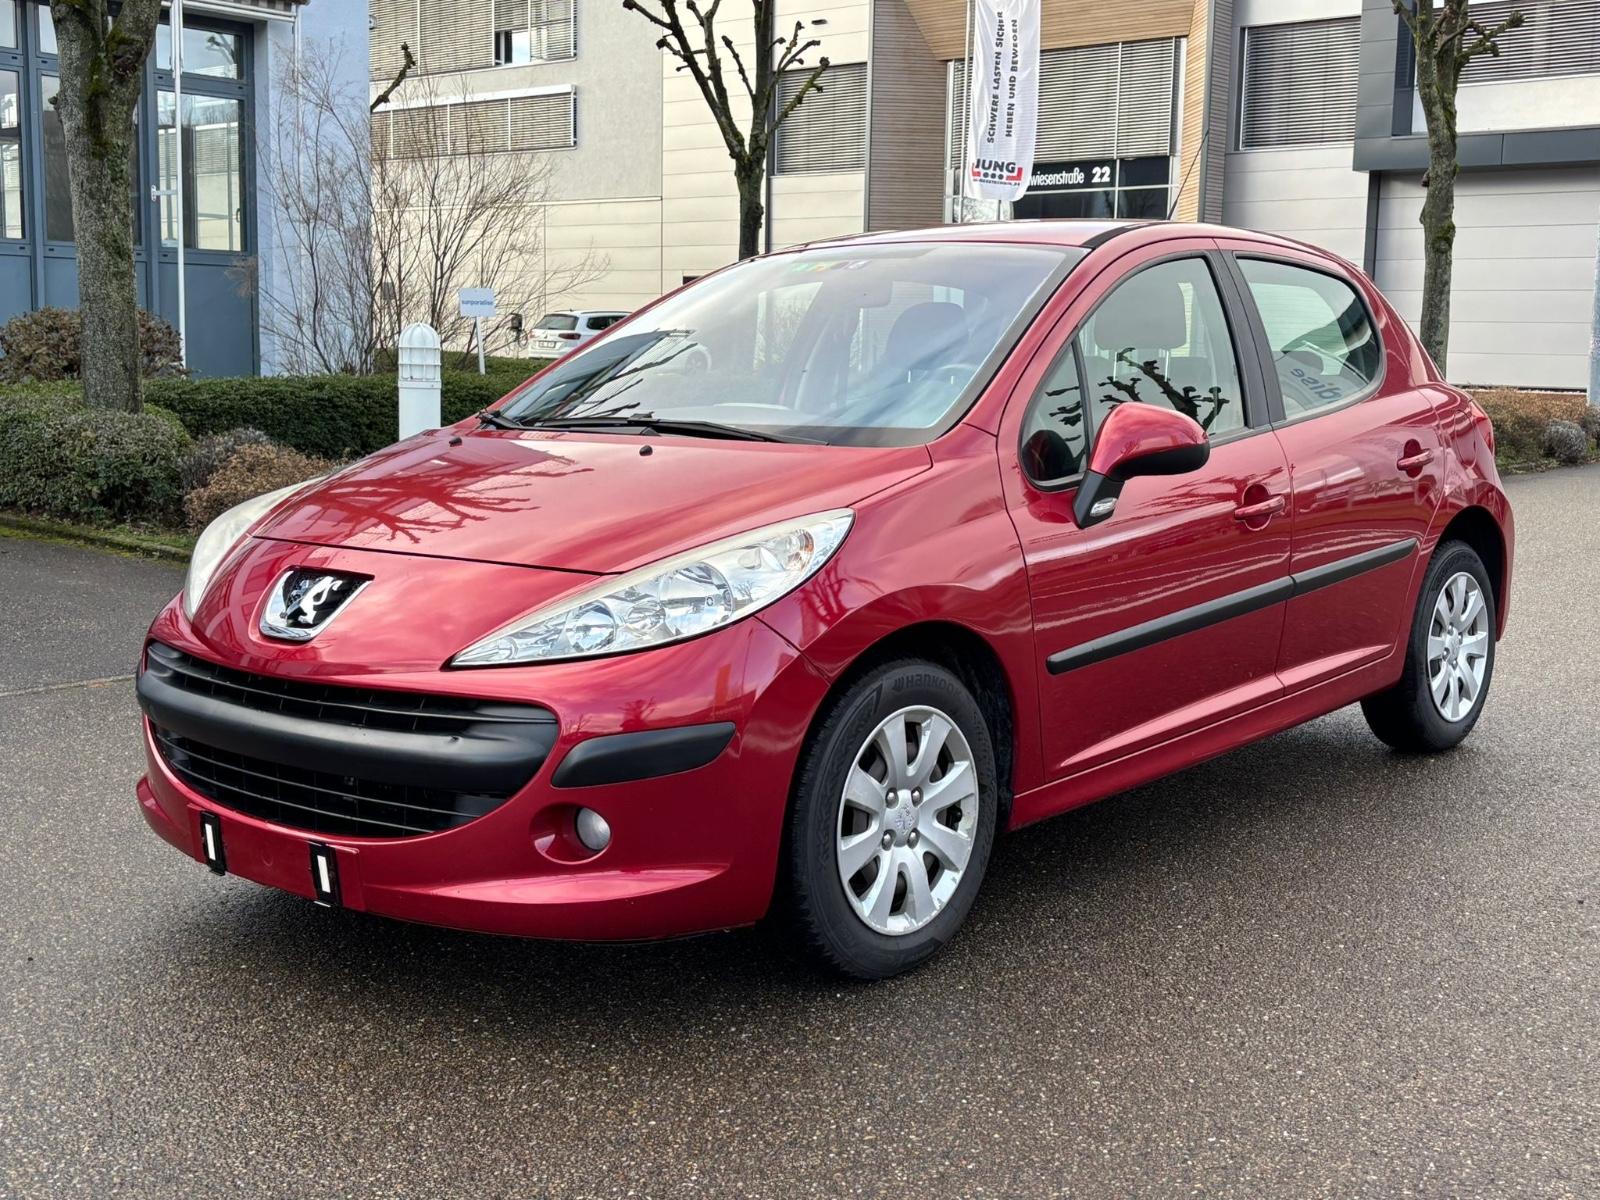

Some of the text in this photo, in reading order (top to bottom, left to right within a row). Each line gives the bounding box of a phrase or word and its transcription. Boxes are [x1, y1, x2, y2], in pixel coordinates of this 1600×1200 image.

[987, 11, 1004, 144] SCHWERE LASTEN SICHER
[1008, 75, 1017, 99] UND
[1005, 103, 1015, 137] HEBEN
[975, 158, 1016, 173] JUNG
[1029, 167, 1085, 187] wiesenstraße
[1091, 165, 1111, 183] 22
